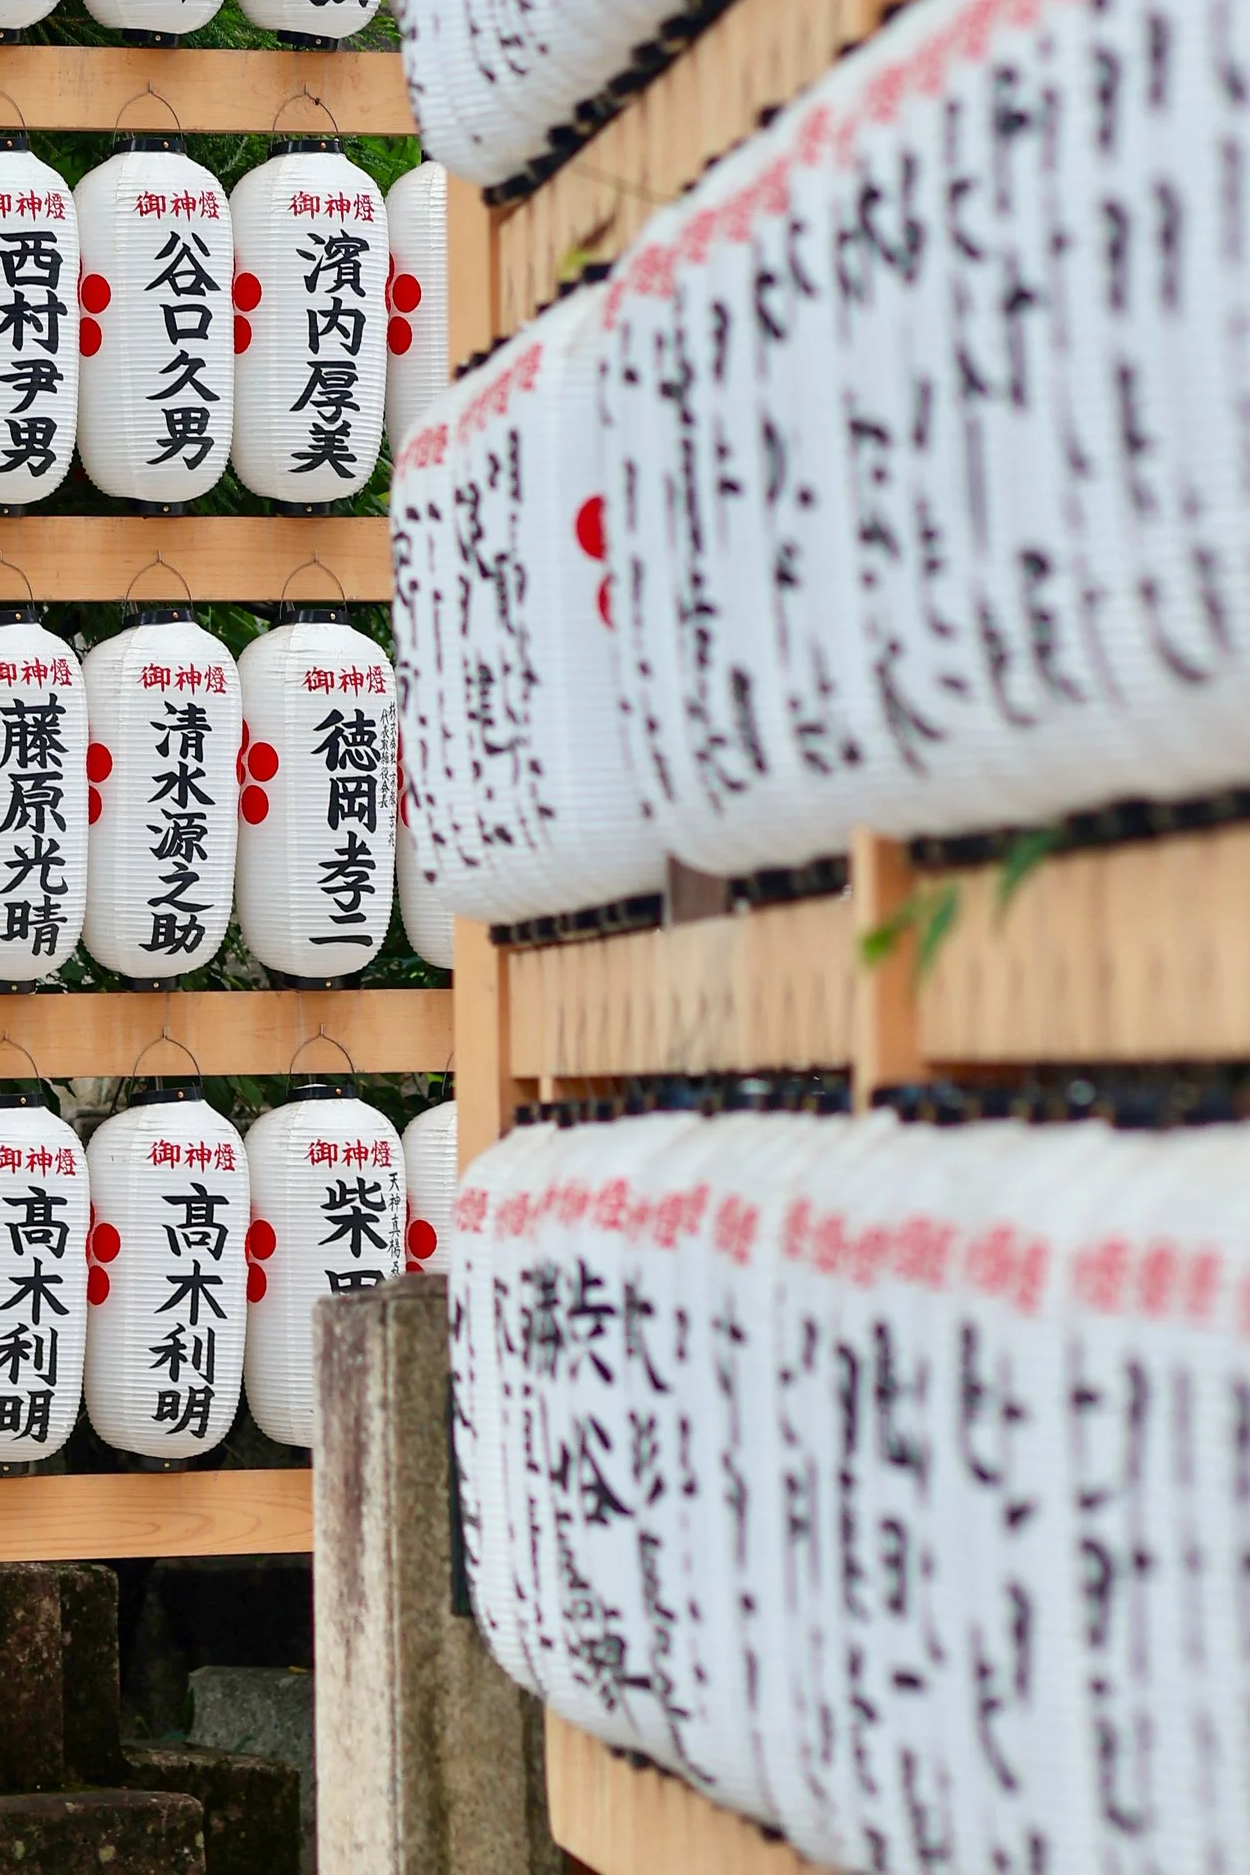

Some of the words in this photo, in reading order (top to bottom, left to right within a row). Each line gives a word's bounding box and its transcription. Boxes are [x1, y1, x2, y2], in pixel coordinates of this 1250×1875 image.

[136, 191, 218, 219] 御神燈
[290, 192, 373, 221] 御神燈
[144, 231, 221, 470] 谷口久男
[141, 664, 226, 694] 御神燈
[304, 665, 386, 694] 御神燈
[138, 701, 216, 956] 清水源之助
[309, 709, 382, 949] 徳岡孝二
[150, 1140, 234, 1171] 御神燈
[308, 1140, 390, 1168] 御神燈
